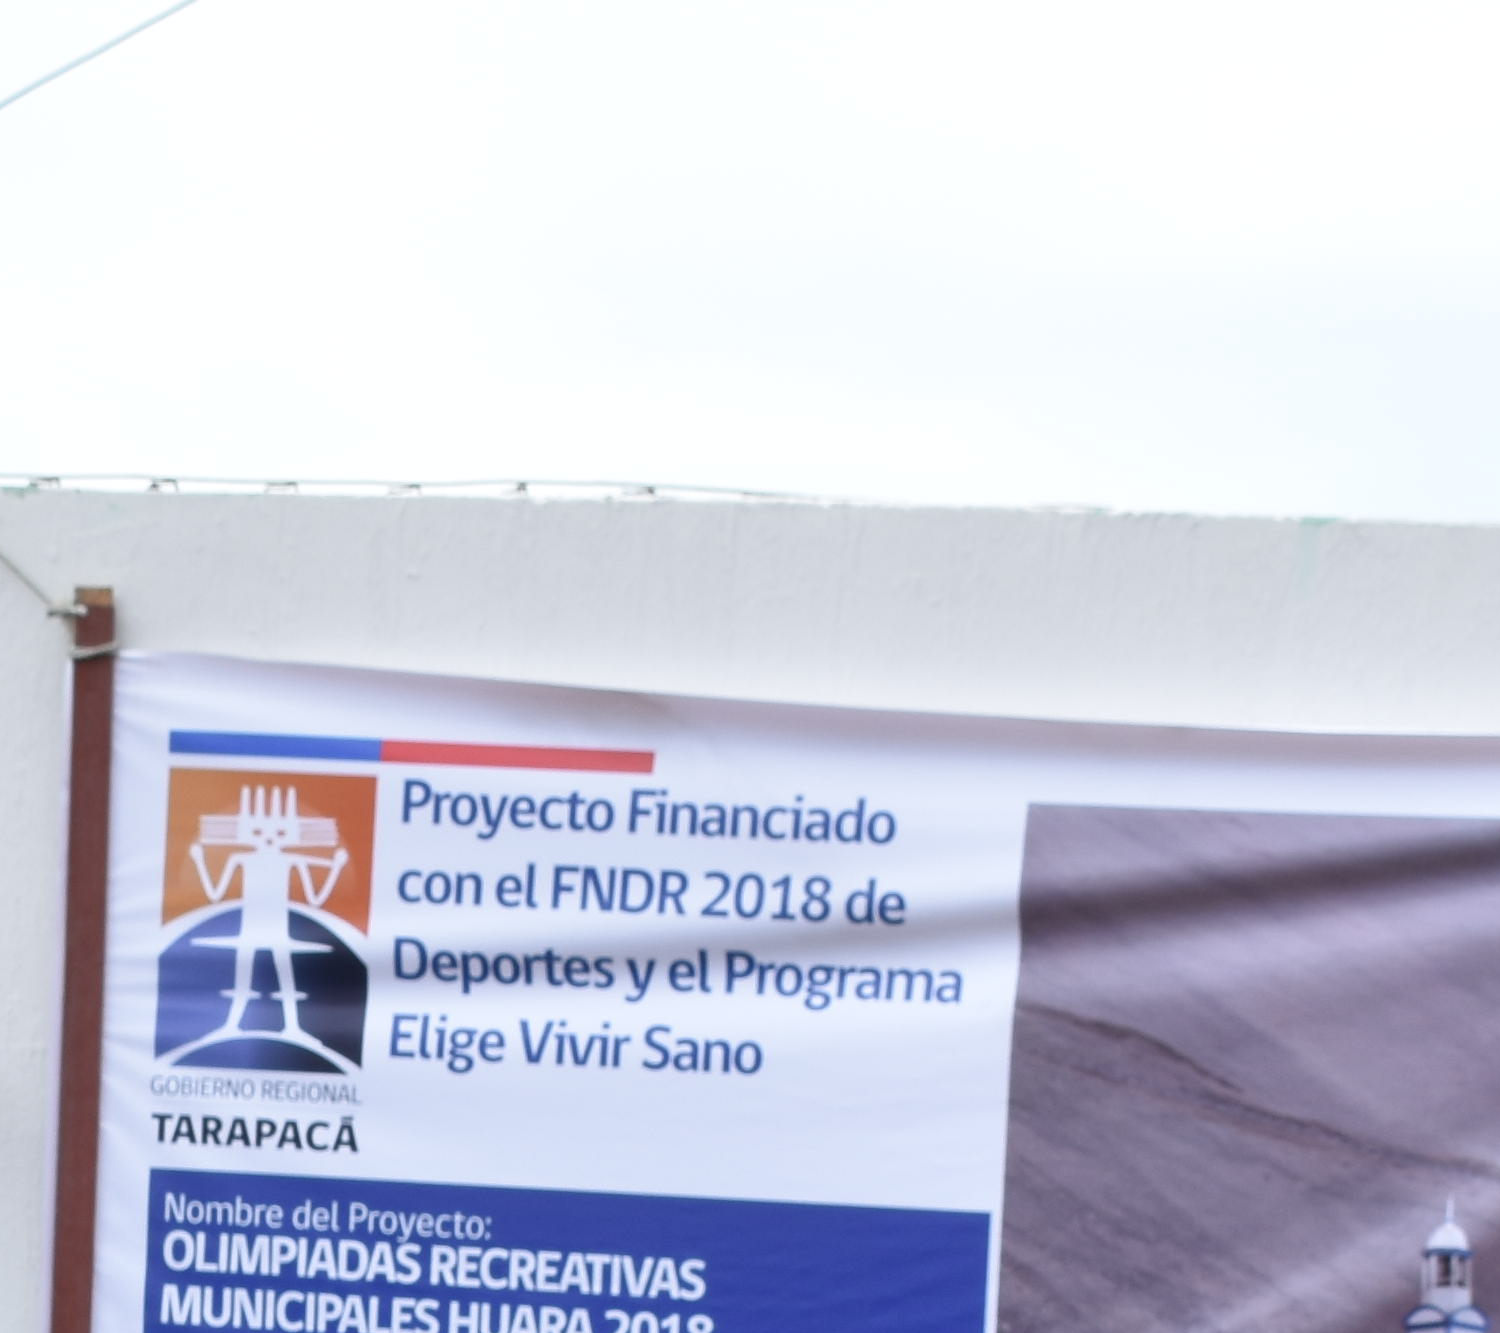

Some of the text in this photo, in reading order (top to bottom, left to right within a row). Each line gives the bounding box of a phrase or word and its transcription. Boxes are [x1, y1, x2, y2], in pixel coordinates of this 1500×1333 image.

[402, 779, 897, 845] Proyecto Financiado
[398, 867, 907, 926] con el FNDR 2018 de
[394, 939, 962, 1009] Deportes y el Programa
[390, 1014, 764, 1074] Elige Vivir Sano
[150, 1075, 361, 1105] GOBIERNO REGIONAL
[153, 1112, 359, 1154] TARAPACÁ
[164, 1192, 492, 1245] Nombre del Proyecto:
[163, 1232, 707, 1301] OLIMPIADAS RECREATIVAS
